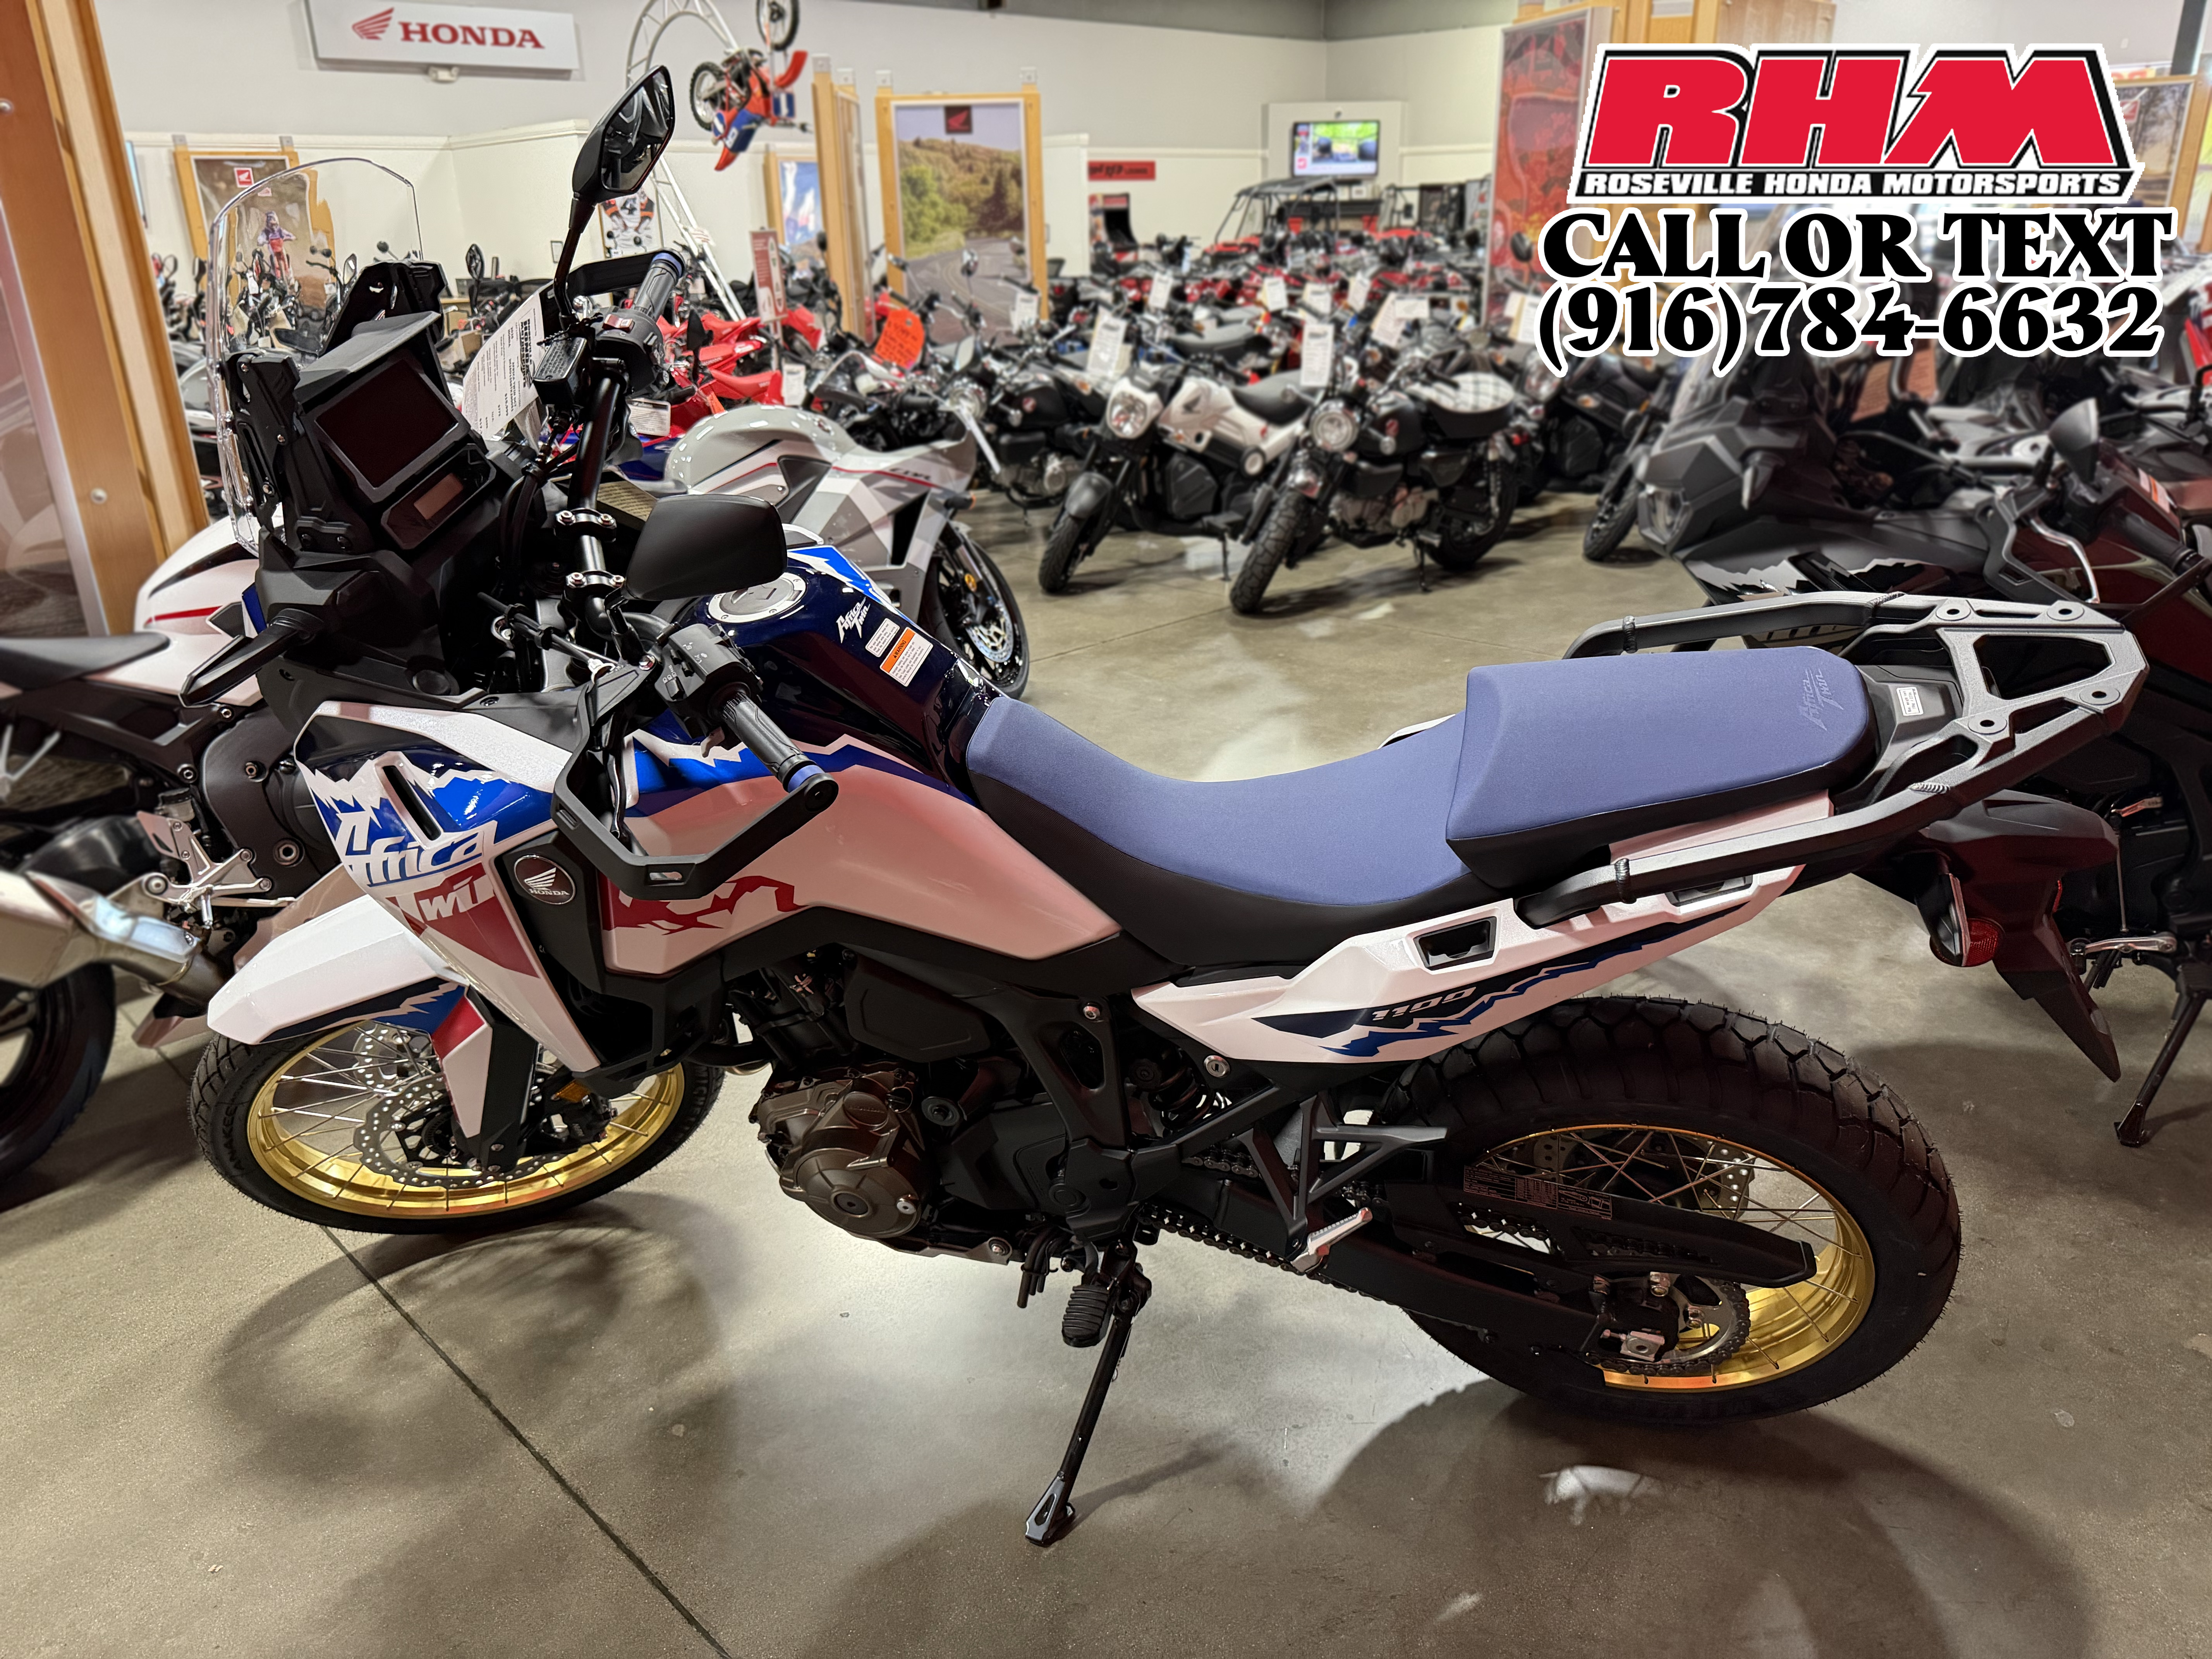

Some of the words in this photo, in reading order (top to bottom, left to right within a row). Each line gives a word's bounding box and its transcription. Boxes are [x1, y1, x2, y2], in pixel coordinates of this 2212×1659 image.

[397, 21, 544, 49] HONDA
[836, 596, 867, 644] Africa
[895, 640, 907, 656] WARNING
[335, 810, 498, 887] Africa
[1372, 986, 1477, 1021] 1100
